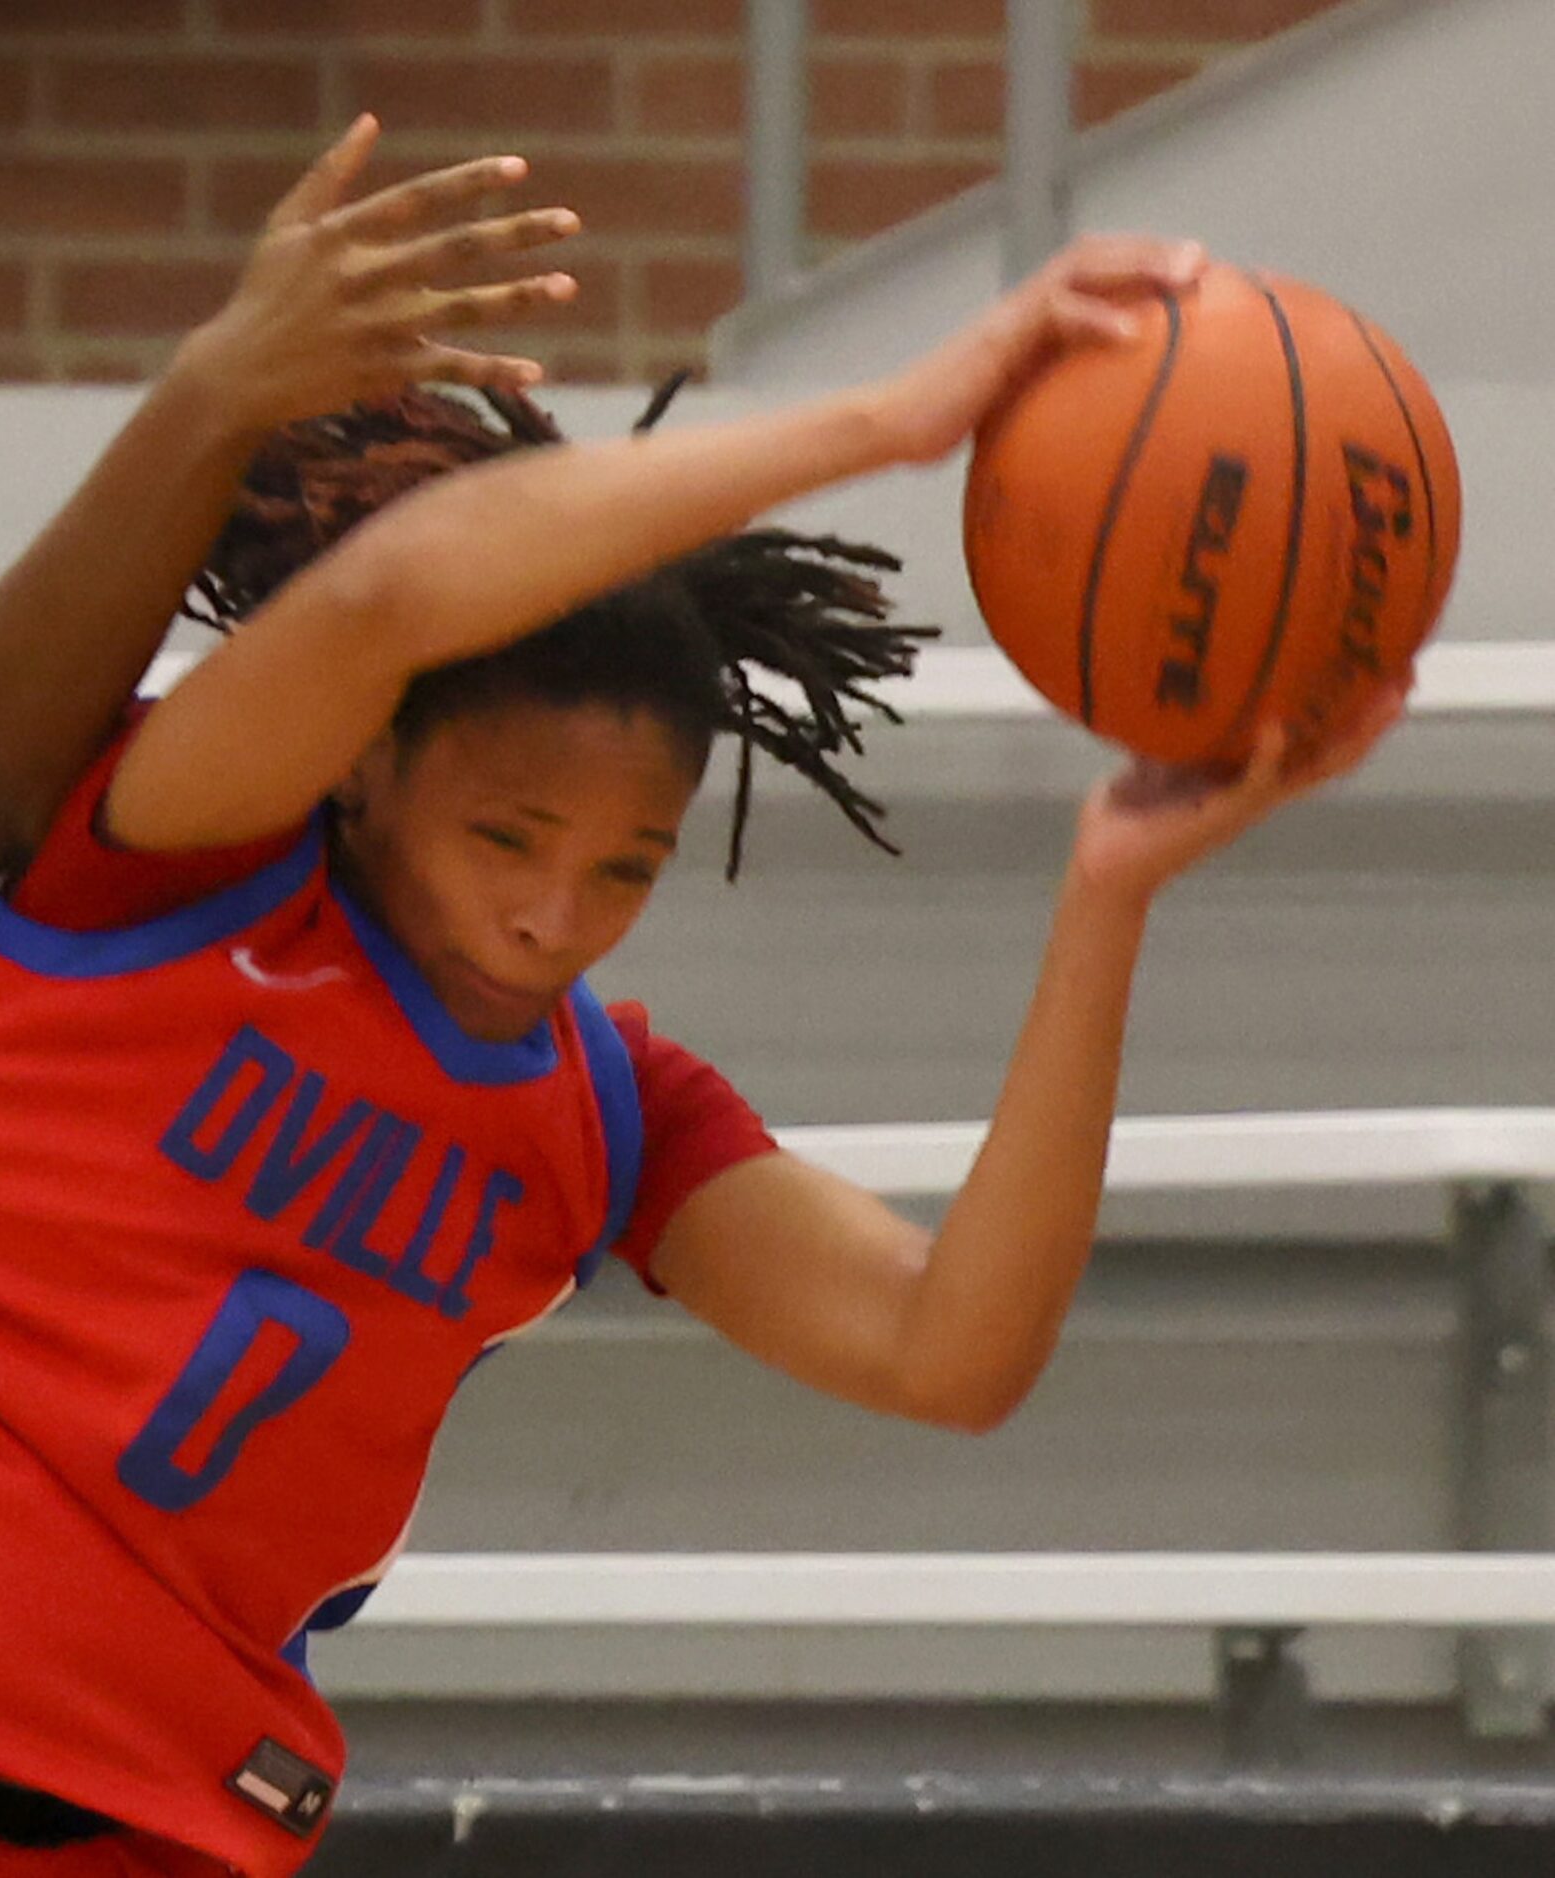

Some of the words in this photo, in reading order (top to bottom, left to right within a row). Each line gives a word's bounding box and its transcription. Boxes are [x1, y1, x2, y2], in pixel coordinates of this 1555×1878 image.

[1157, 454, 1249, 712] ELITE
[157, 1023, 524, 1322] DVILLE
[117, 1267, 350, 1513] 0
